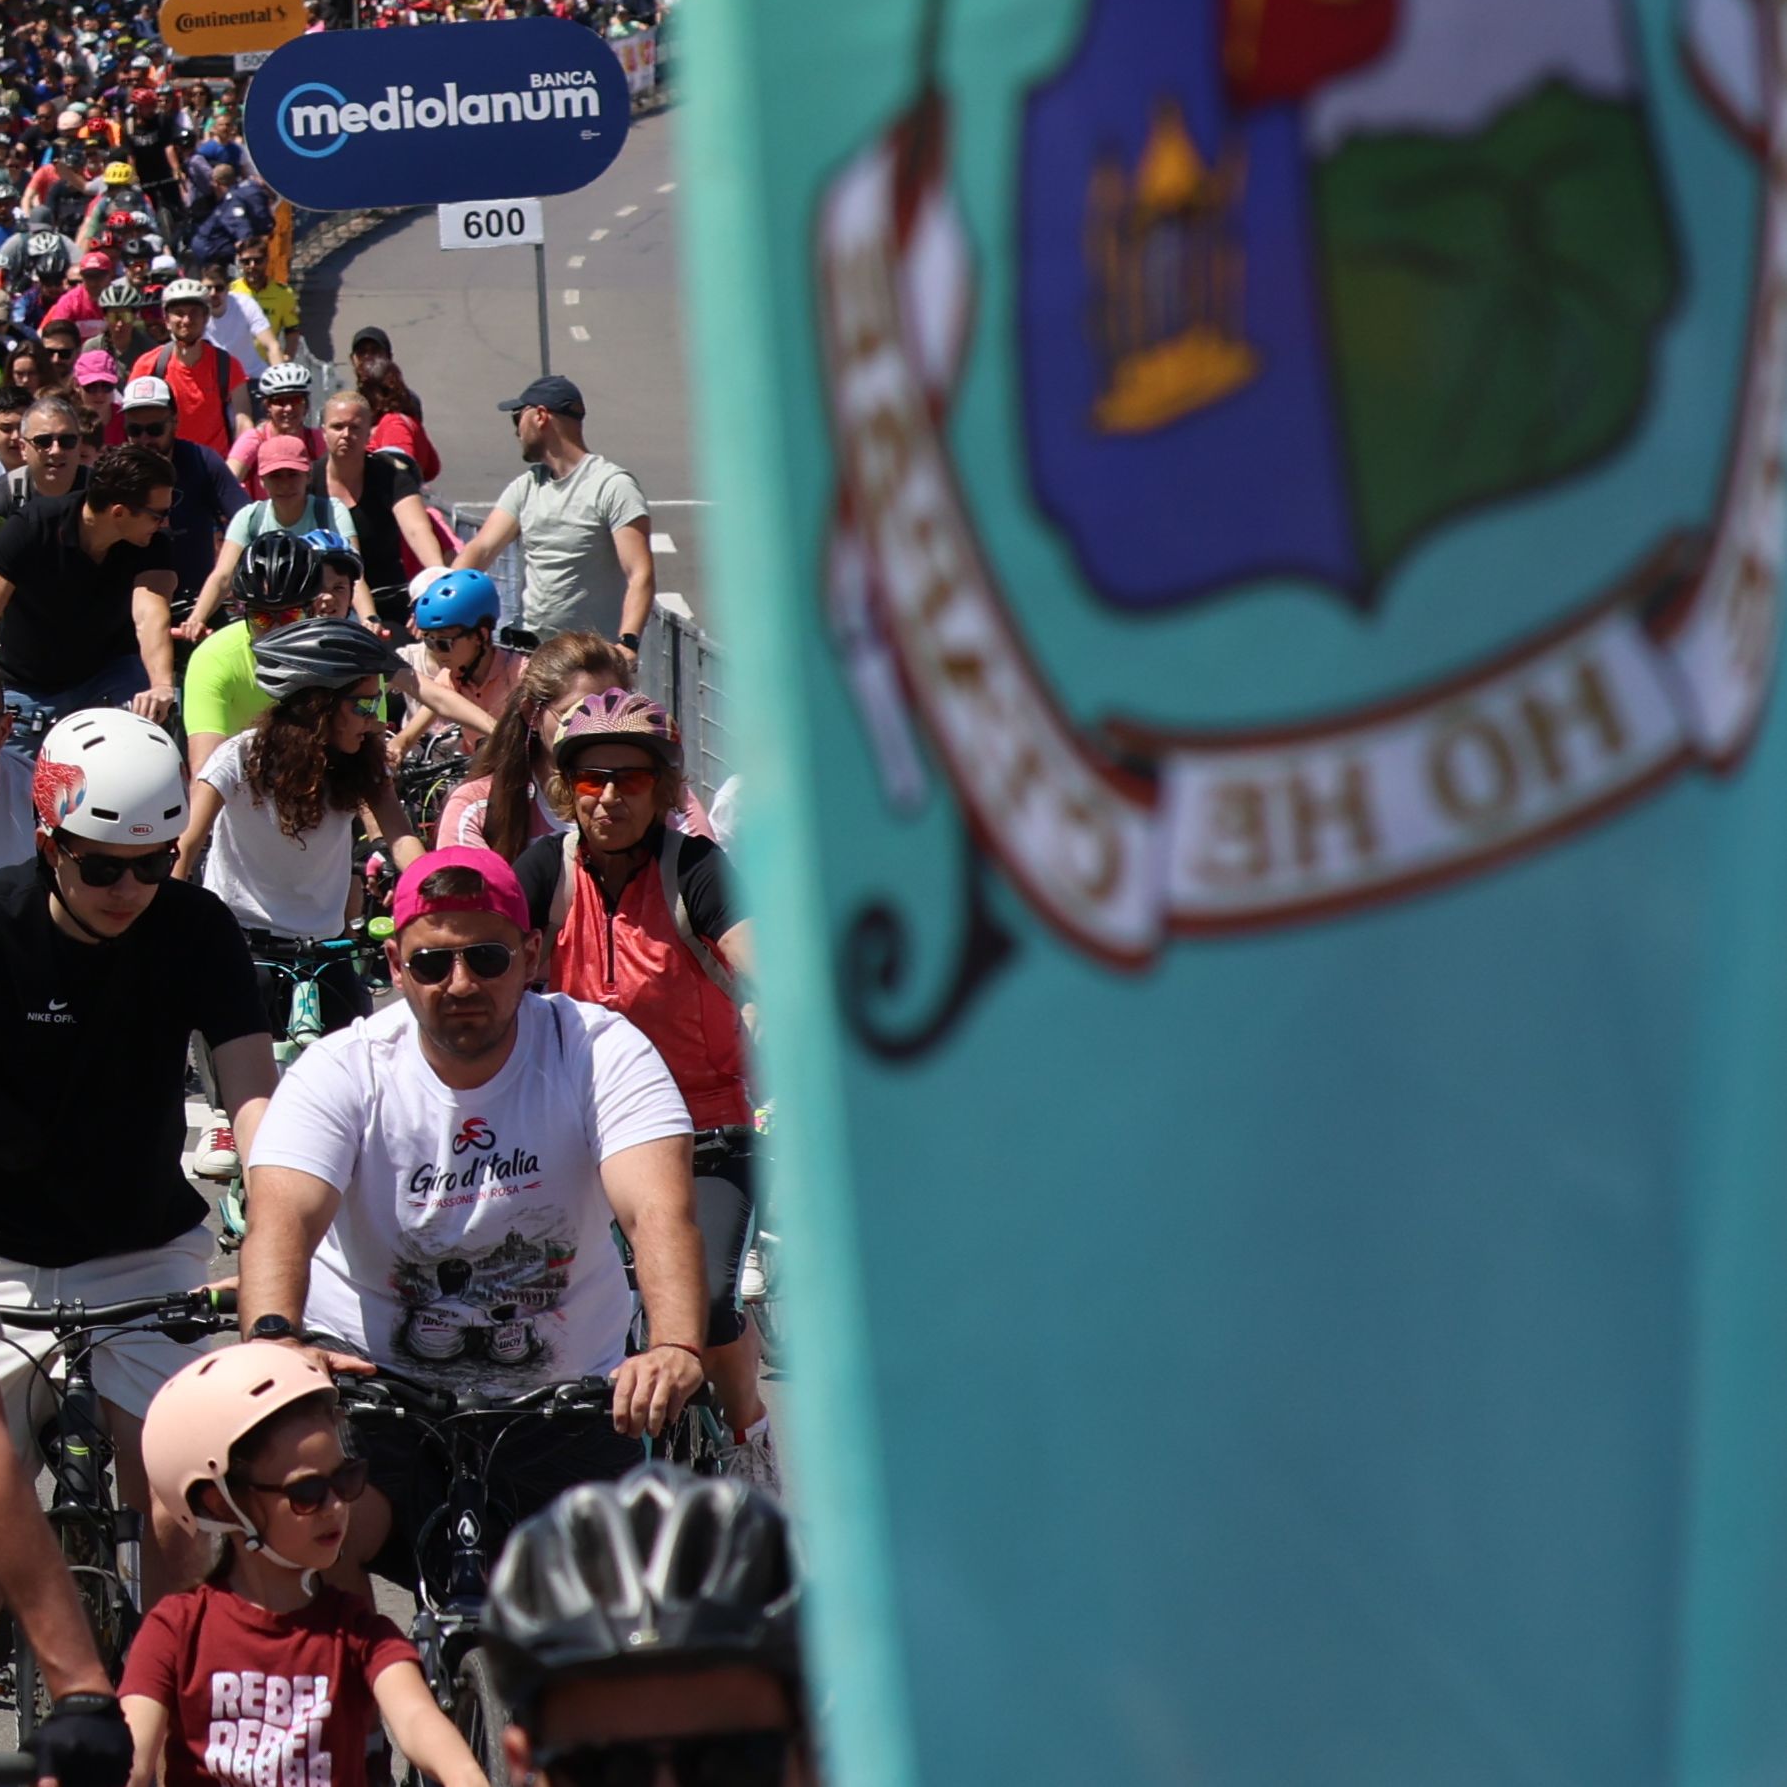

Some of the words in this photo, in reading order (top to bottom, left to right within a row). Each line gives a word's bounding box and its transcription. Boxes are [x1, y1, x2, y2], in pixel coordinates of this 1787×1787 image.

[175, 10, 272, 34] Continental
[530, 70, 597, 88] BANCA
[290, 81, 601, 138] mediolanum
[463, 206, 526, 240] 600
[27, 1012, 51, 1022] NIKE
[410, 1163, 458, 1199] Giro
[489, 1184, 520, 1200] ROSA
[211, 1671, 333, 1727] REBEL
